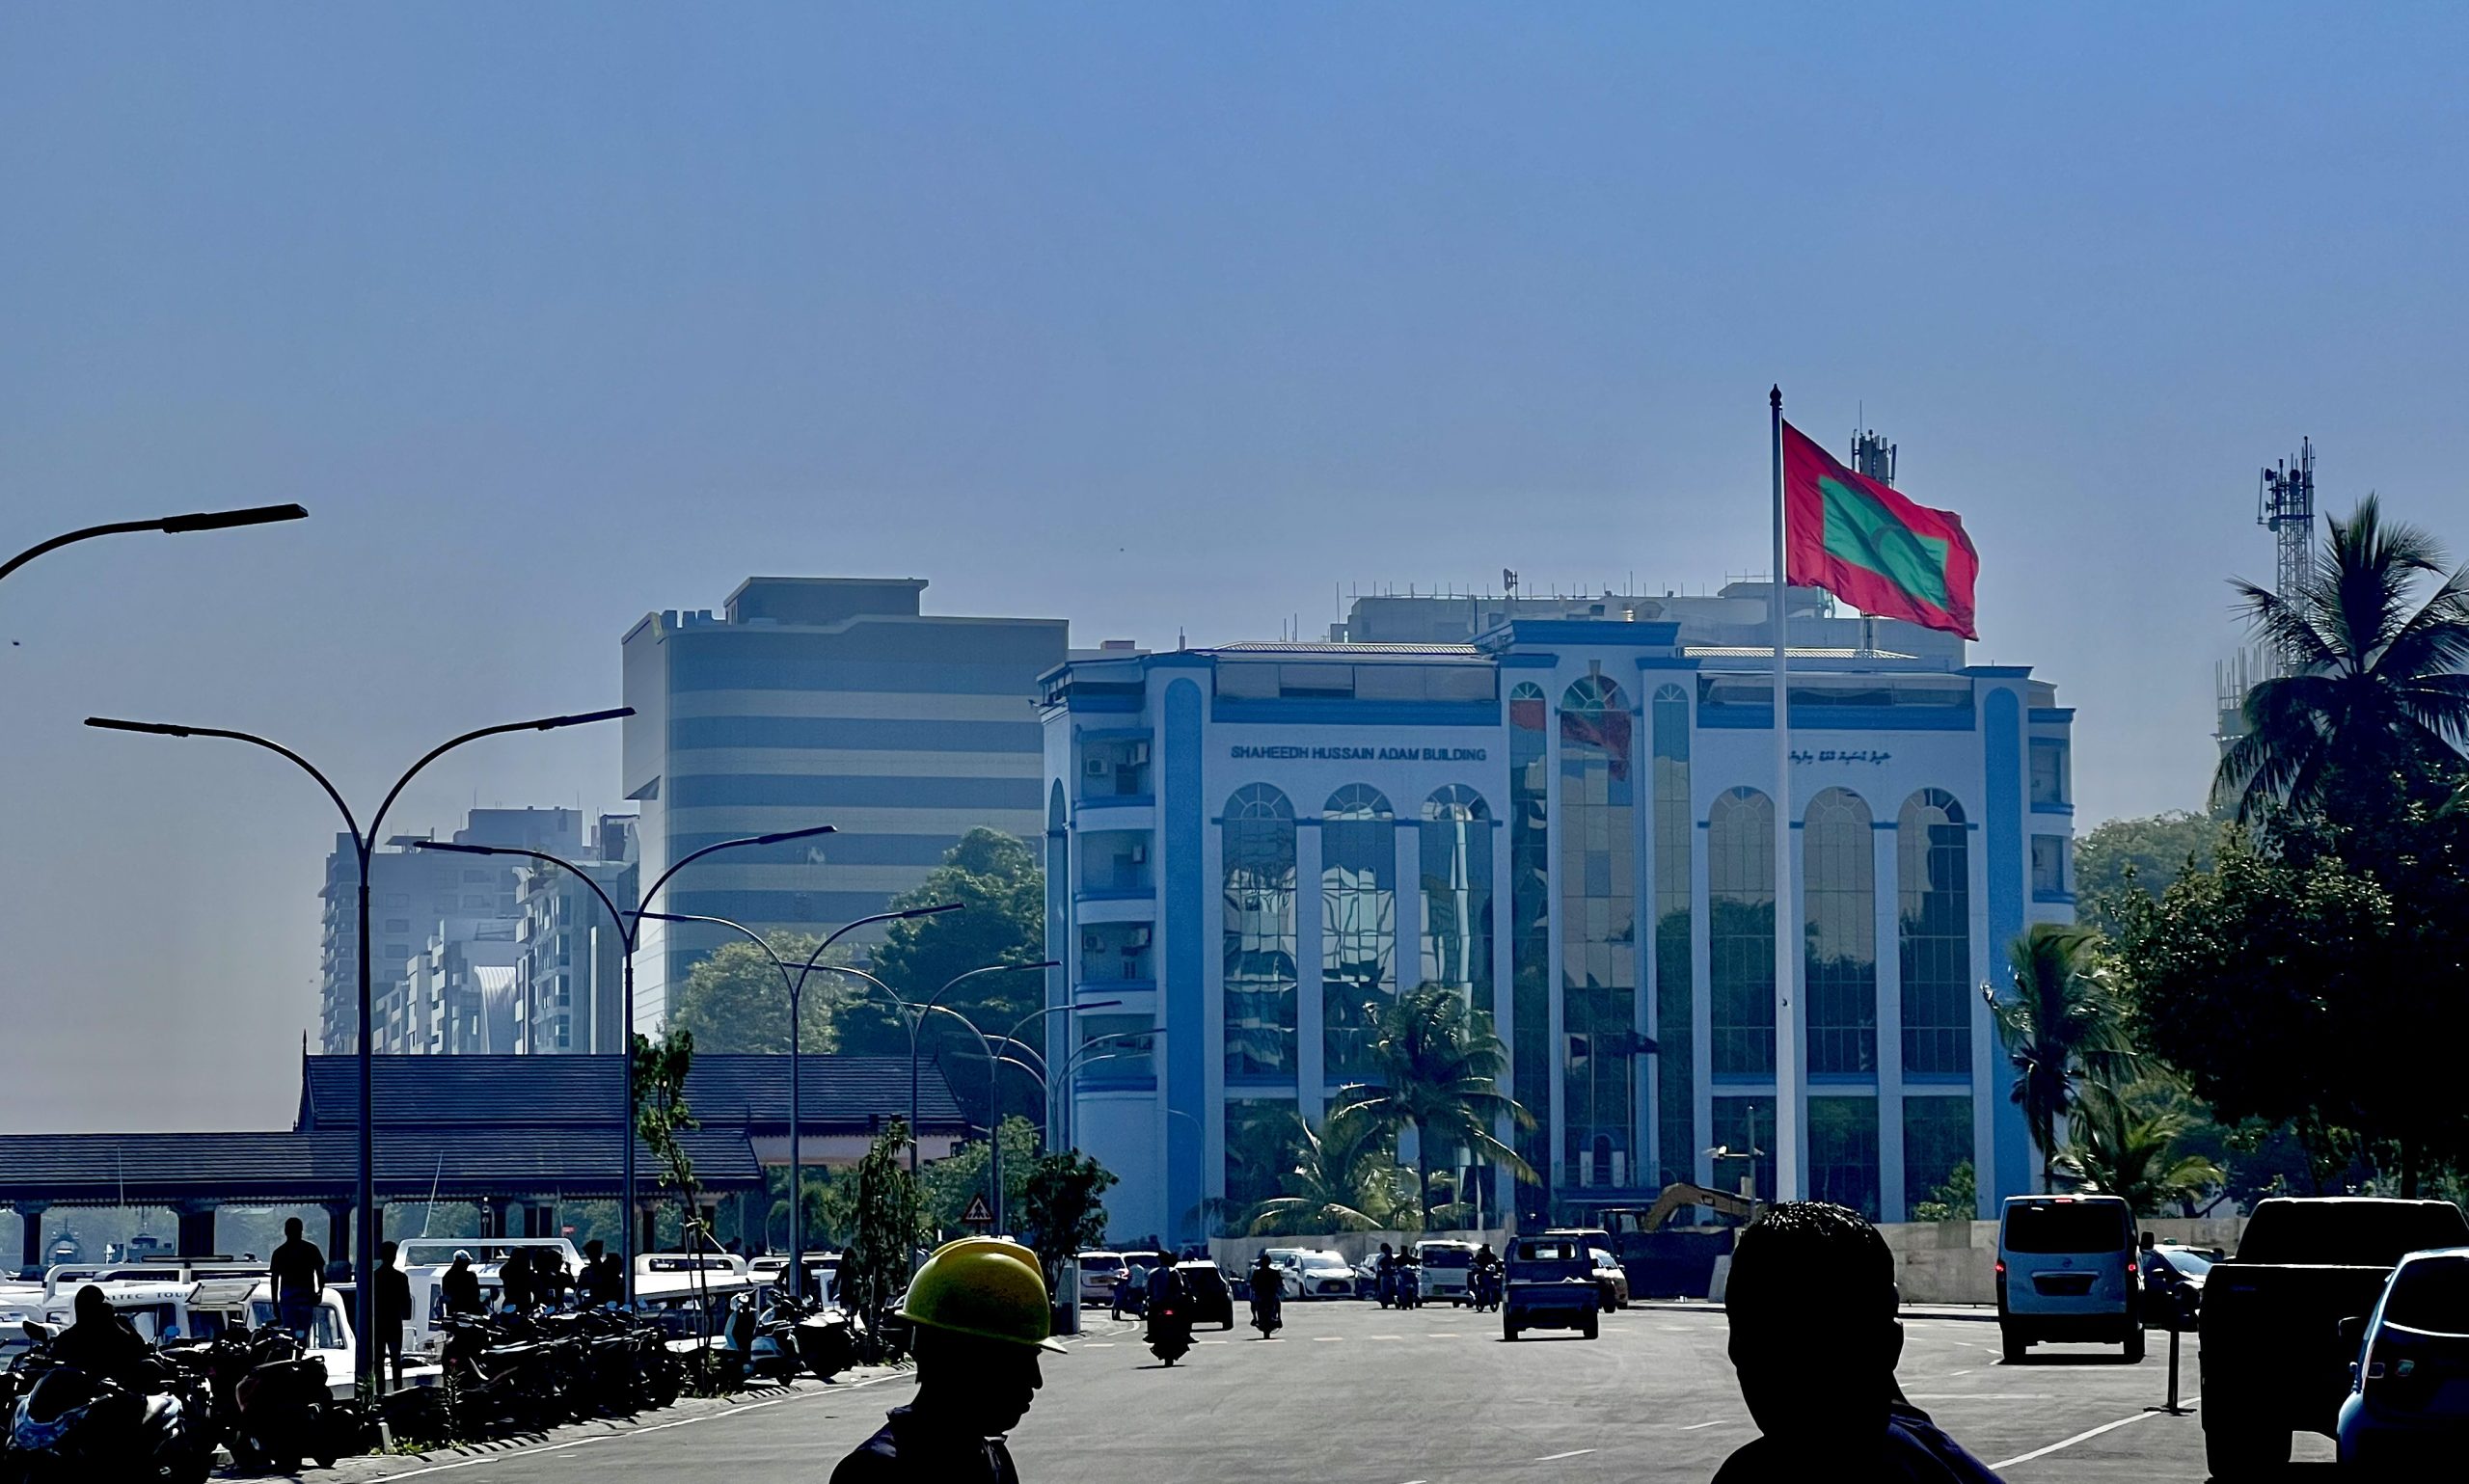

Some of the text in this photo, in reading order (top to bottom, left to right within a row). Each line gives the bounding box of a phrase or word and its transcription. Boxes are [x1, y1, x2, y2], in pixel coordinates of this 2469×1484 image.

[1231, 745, 1487, 762] SHAHEEDH HUSSAIN ADAM BUILDING
